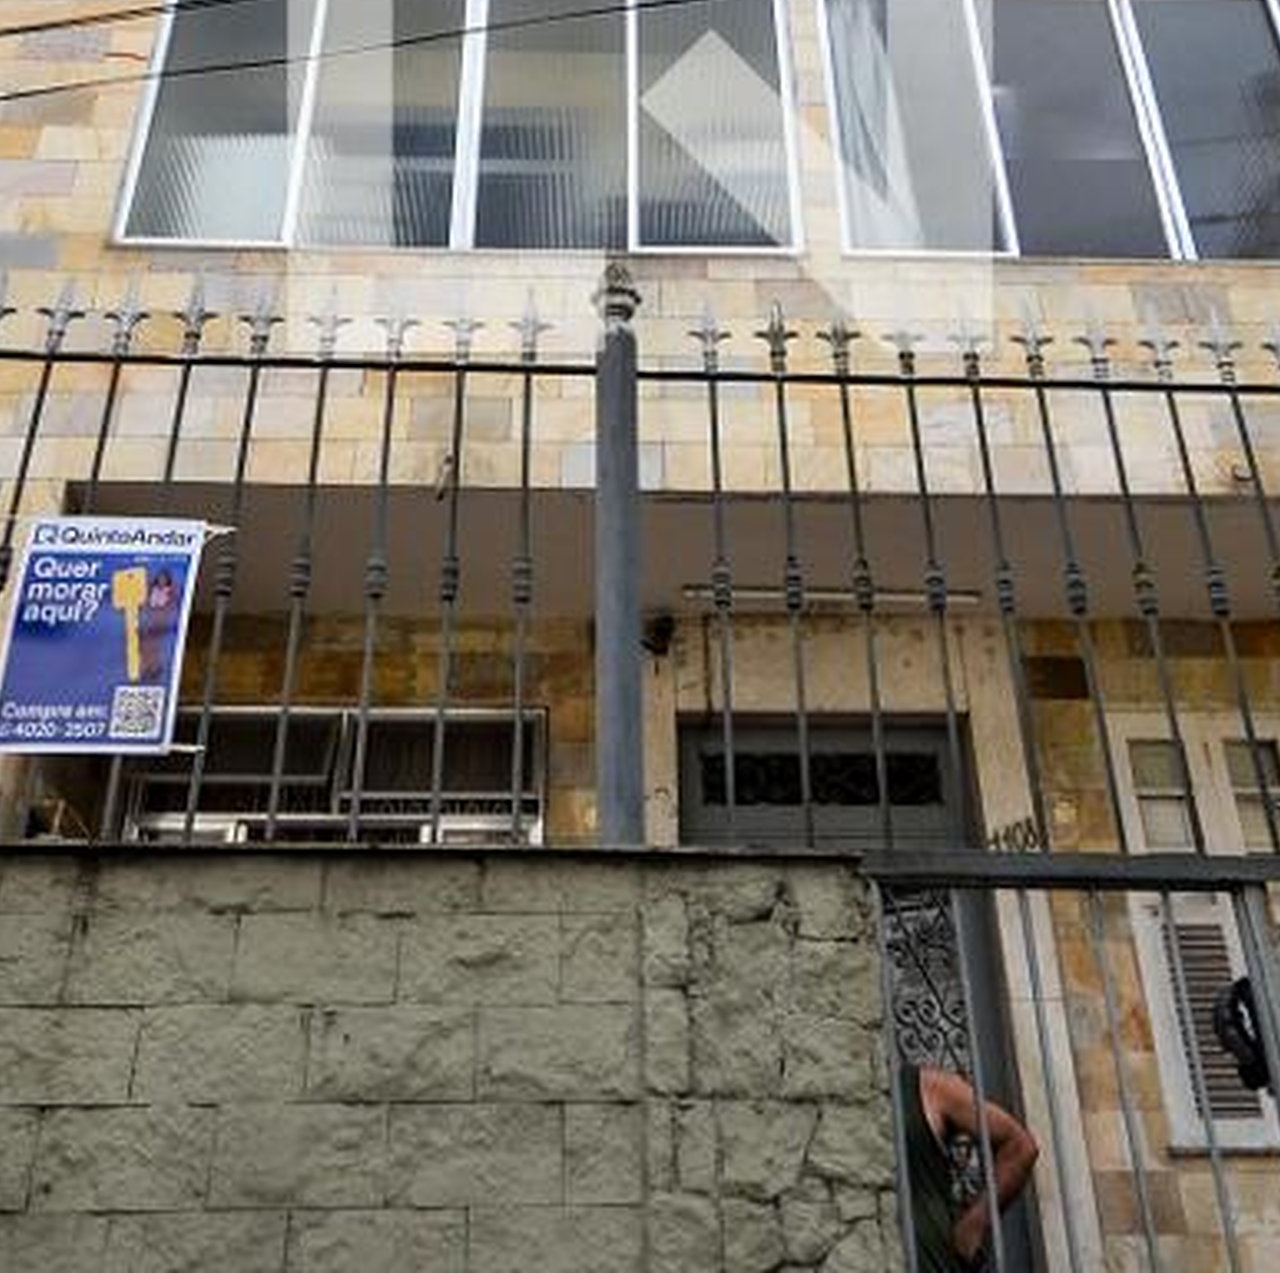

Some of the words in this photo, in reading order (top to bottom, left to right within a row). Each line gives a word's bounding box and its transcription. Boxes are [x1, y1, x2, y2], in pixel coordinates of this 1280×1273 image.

[60, 527, 195, 547] QuintoAndar
[34, 557, 101, 579] Quer
[27, 581, 108, 601] morar
[22, 601, 98, 624] aqui?
